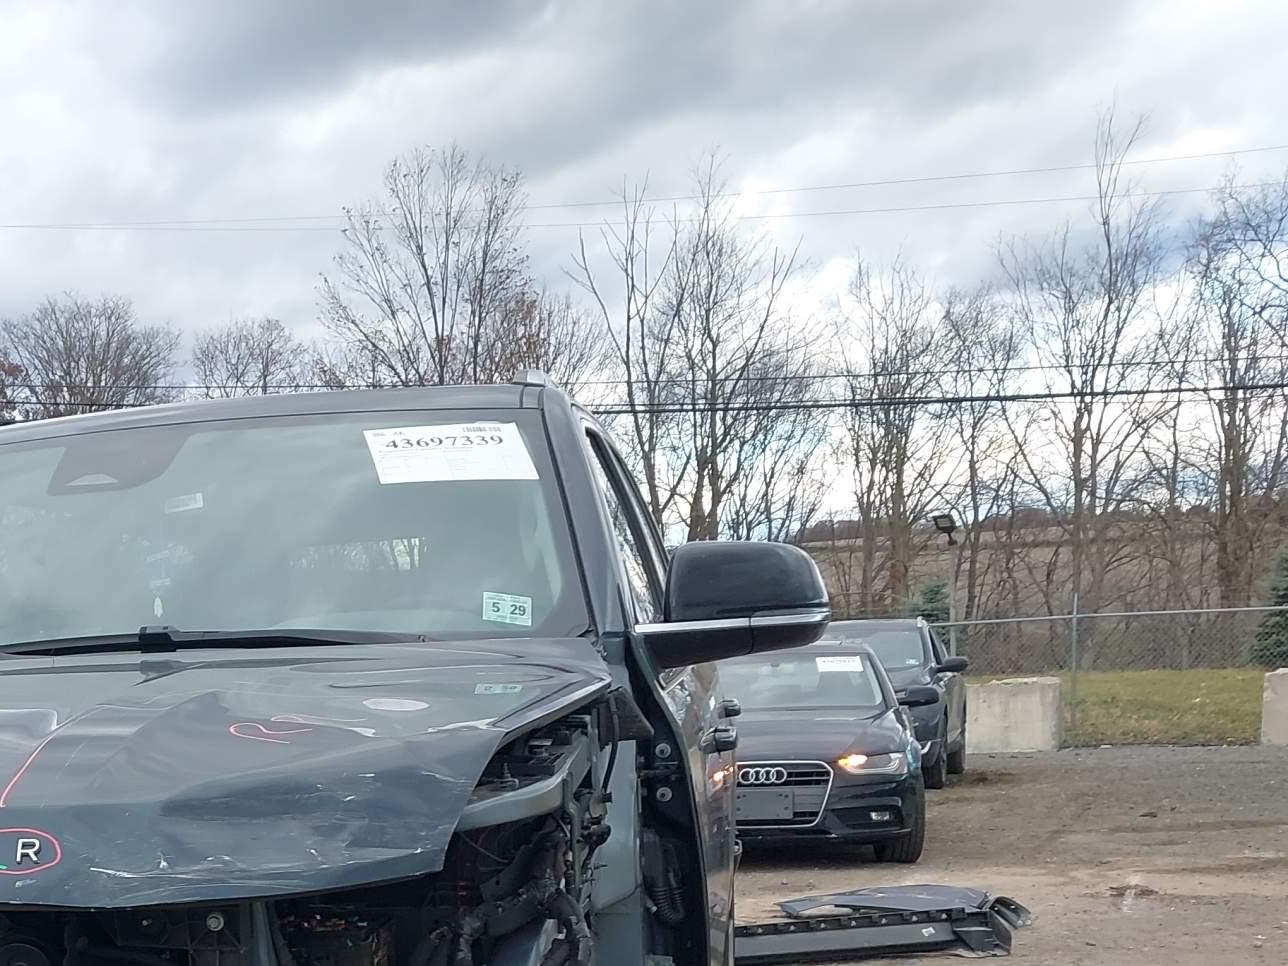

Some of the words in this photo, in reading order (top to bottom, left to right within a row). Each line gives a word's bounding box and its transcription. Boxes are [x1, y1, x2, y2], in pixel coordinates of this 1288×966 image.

[385, 434, 504, 449] 43697339
[492, 601, 500, 613] 5
[509, 603, 526, 616] 29
